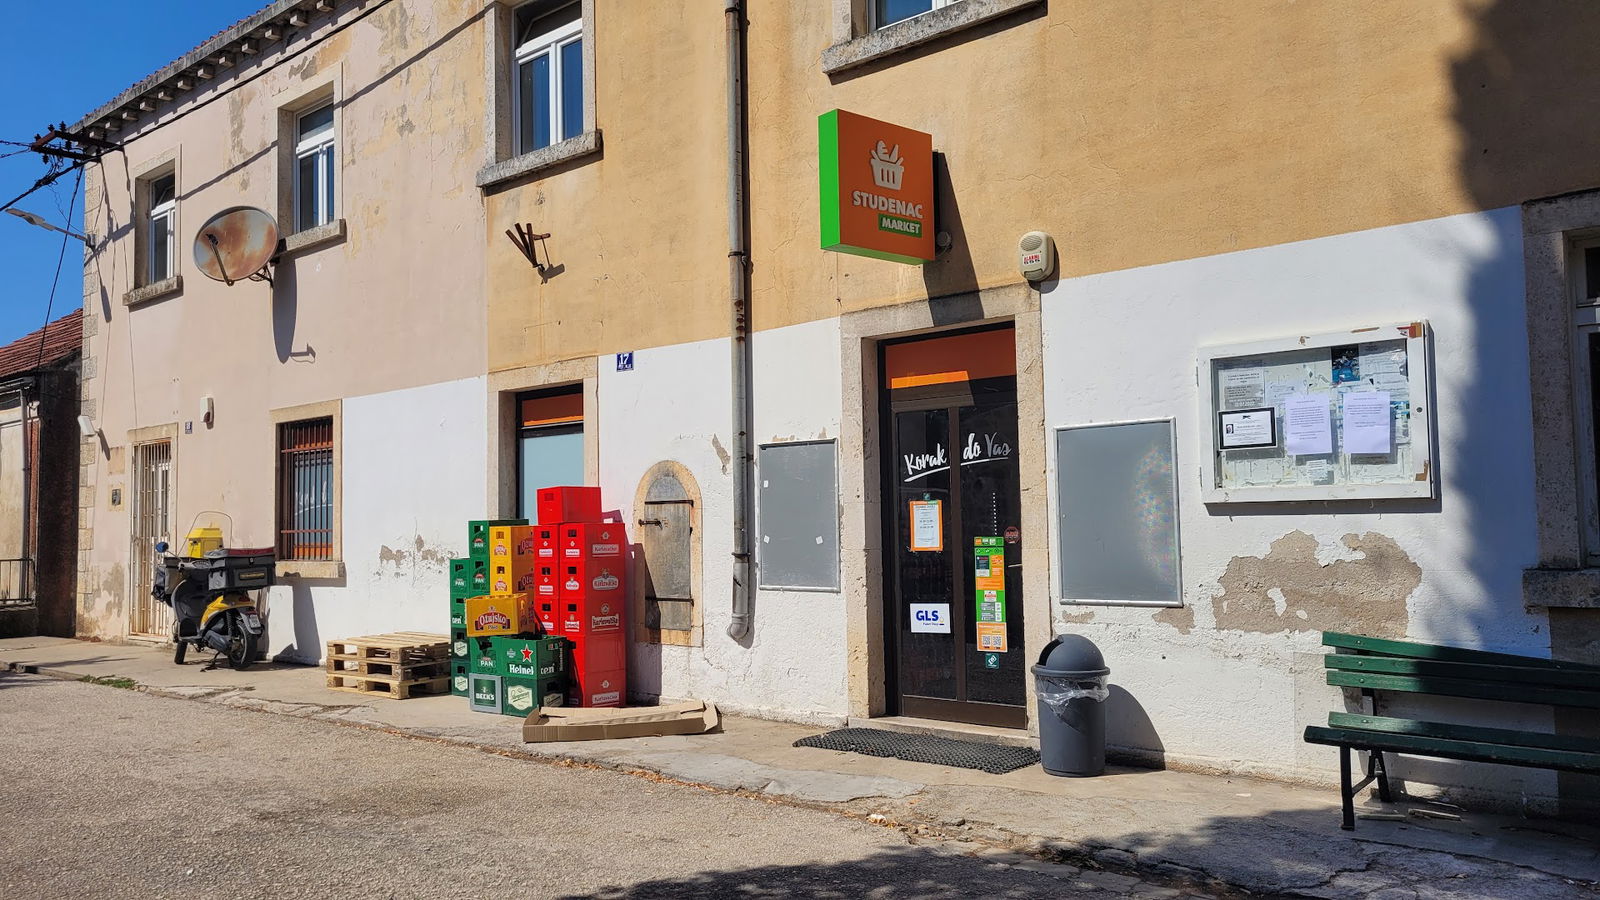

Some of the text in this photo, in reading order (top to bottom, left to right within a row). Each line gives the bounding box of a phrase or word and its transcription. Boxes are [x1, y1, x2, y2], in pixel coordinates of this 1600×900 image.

[853, 190, 923, 219] STUDENAC
[881, 217, 920, 234] MARKET
[620, 353, 630, 365] 17
[904, 432, 1012, 475] Korak do Vas
[916, 610, 939, 622] GLS
[480, 660, 494, 668] PAN
